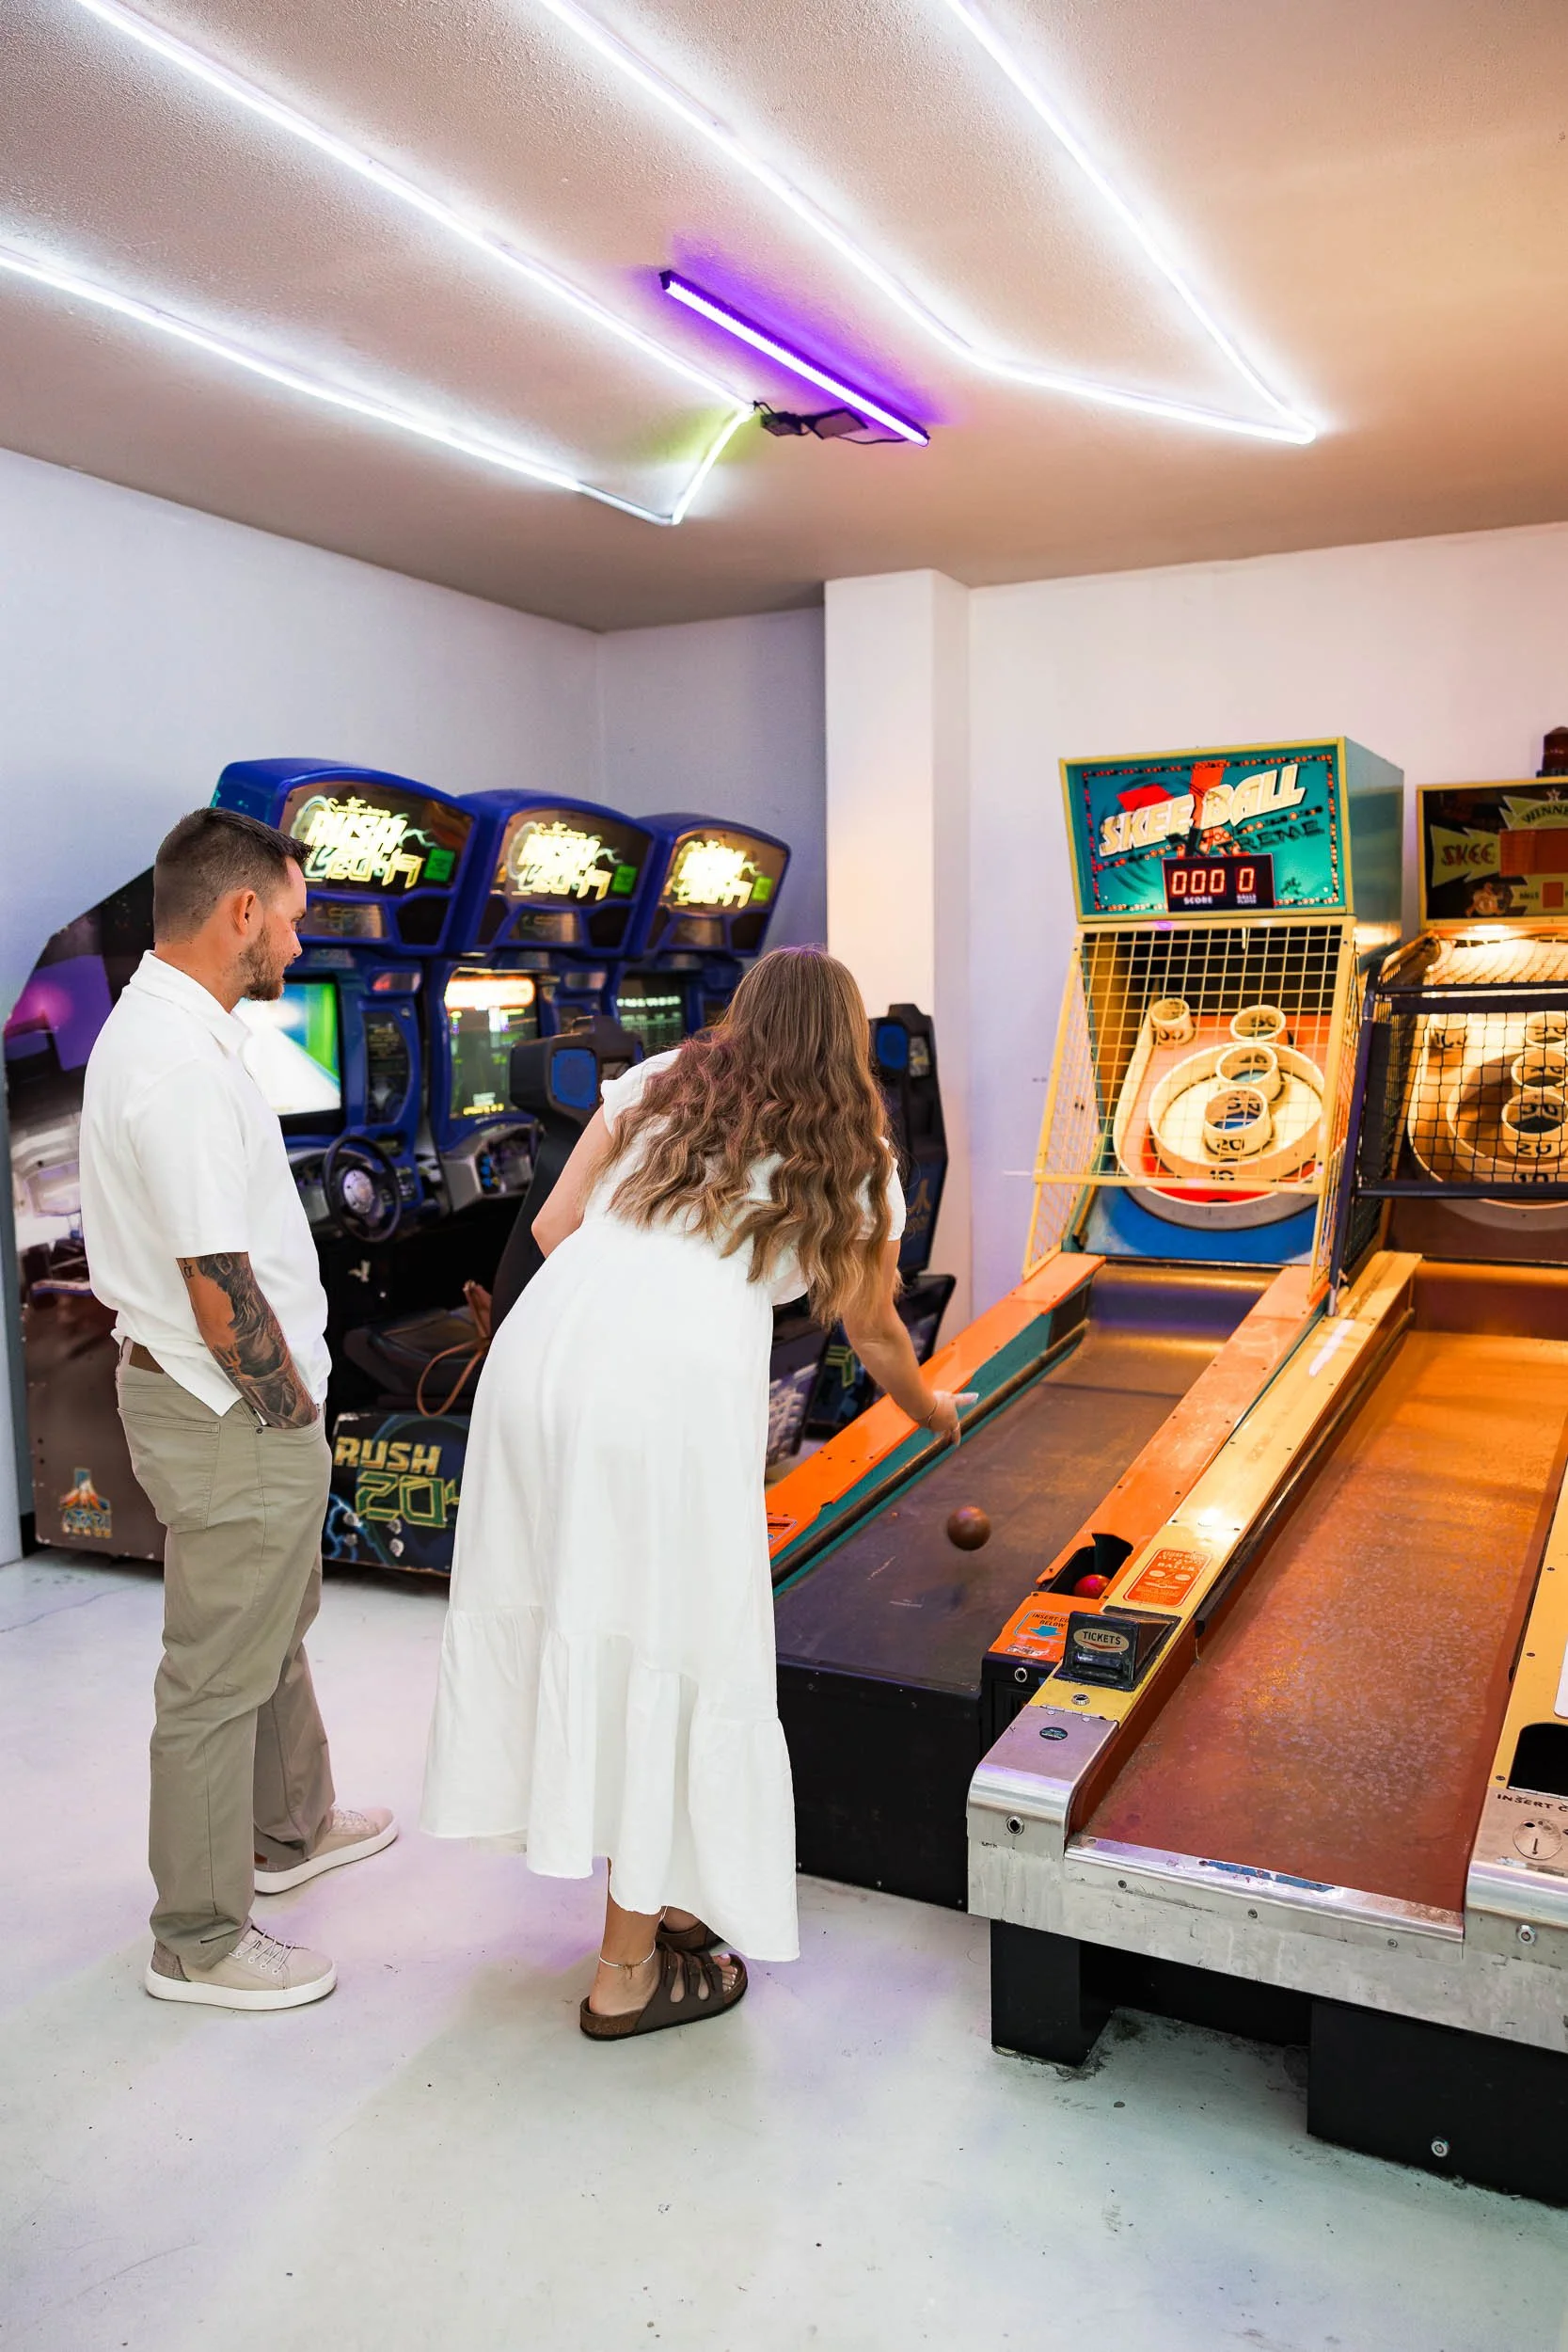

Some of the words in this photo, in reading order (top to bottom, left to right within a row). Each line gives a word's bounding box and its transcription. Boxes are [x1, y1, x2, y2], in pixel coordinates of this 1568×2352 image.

[1100, 793, 1195, 857] SKEE
[1200, 763, 1306, 827] BALL
[1441, 842, 1496, 866] SKEE
[1183, 896, 1213, 905] SCORE
[1517, 1142, 1552, 1156] 20
[333, 1436, 443, 1476] RUSH
[1032, 1613, 1058, 1623] INSERT
[1083, 1630, 1121, 1645] TICKETS
[1497, 1794, 1554, 1808] INSERT
